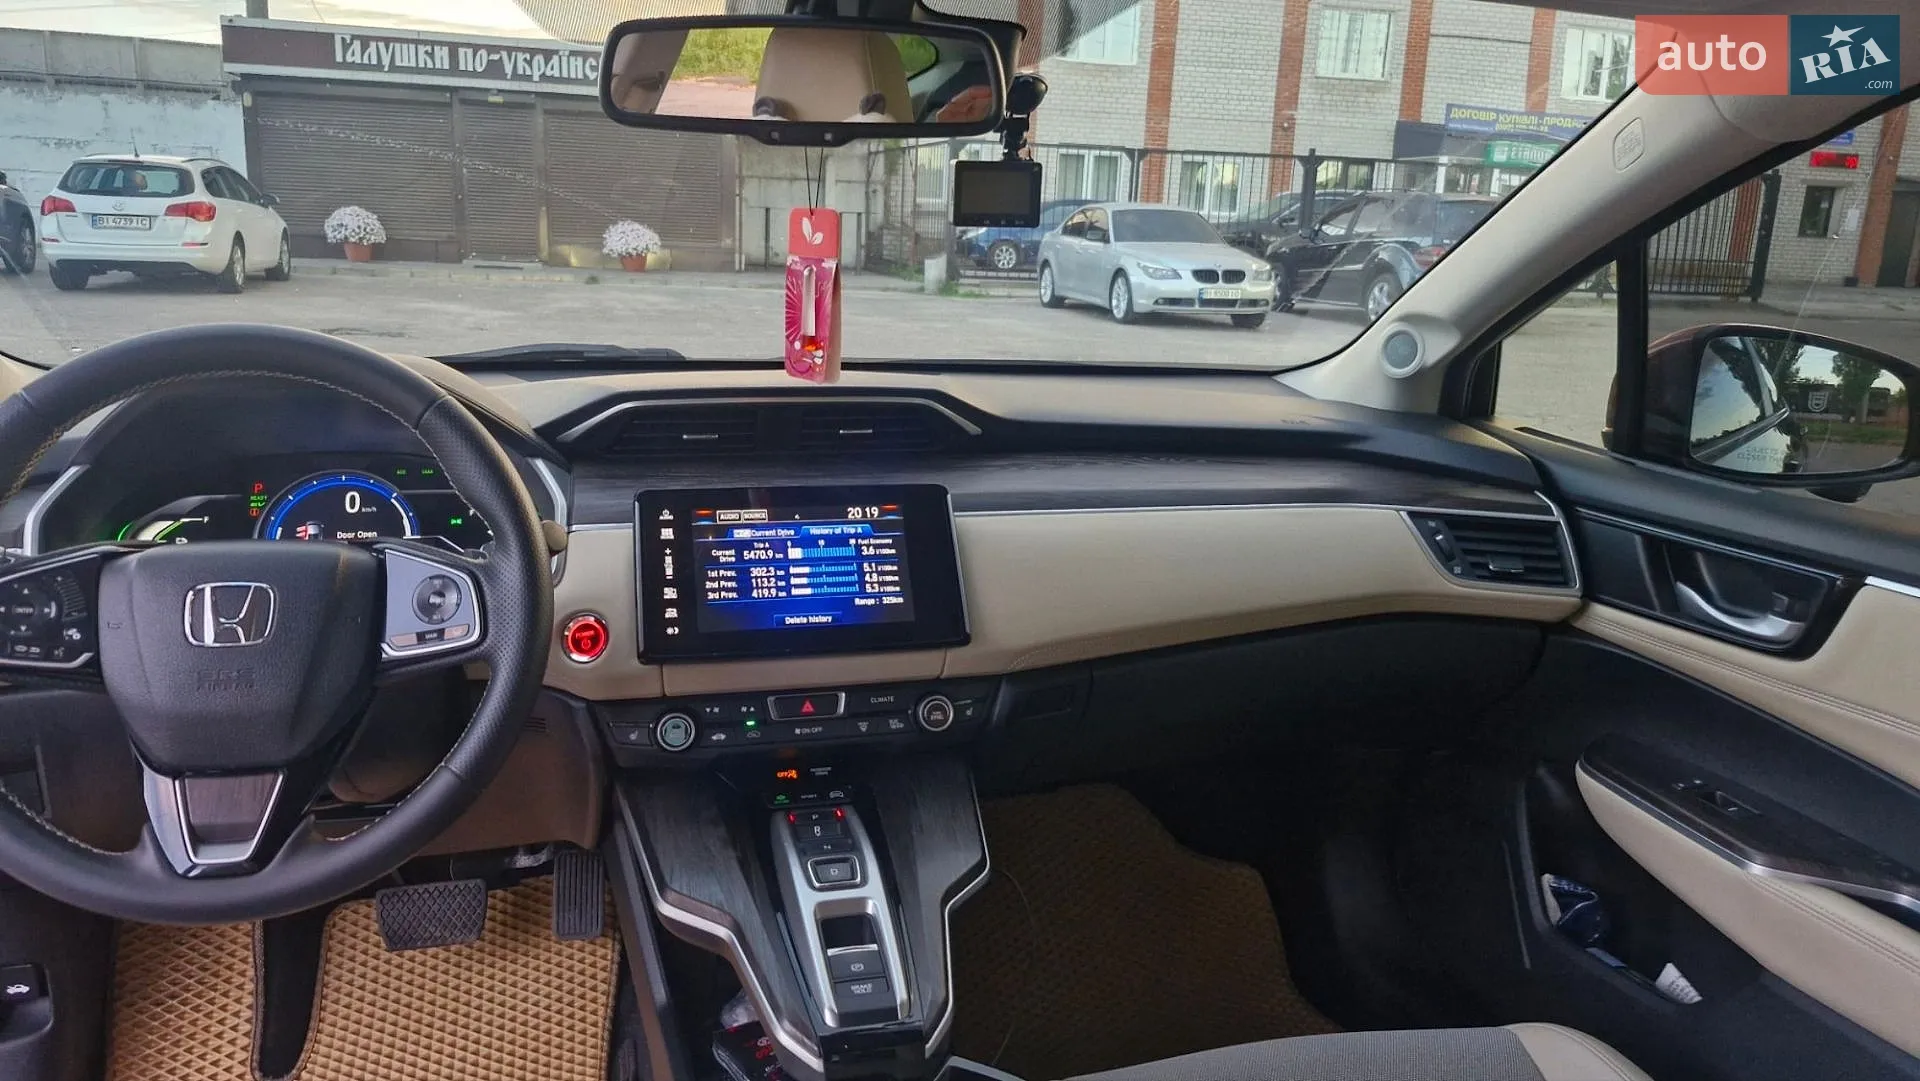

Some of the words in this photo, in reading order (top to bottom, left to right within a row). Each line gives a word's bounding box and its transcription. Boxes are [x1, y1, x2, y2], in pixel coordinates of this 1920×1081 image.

[334, 34, 450, 71] Галушки
[458, 47, 599, 81] по-українс
[1450, 107, 1497, 121] ДОГОВІР
[254, 482, 263, 494] P
[345, 490, 361, 514] 0
[847, 507, 862, 518] 20
[865, 507, 879, 518] 19
[336, 530, 355, 540] Door
[357, 529, 378, 540] Open
[752, 528, 776, 537] Current
[777, 528, 795, 538] Drive
[810, 528, 833, 536] History
[843, 527, 856, 536] Trip
[711, 549, 736, 557] Current
[743, 549, 774, 561] 5470.9
[861, 546, 875, 556] 3.6
[749, 567, 775, 578] 302.3
[863, 563, 876, 572] 5.1
[707, 569, 719, 578] 1st
[720, 569, 738, 578] Prev.
[864, 573, 878, 582] 4.8
[719, 580, 738, 588] Prev.
[751, 578, 776, 588] 113.2
[865, 583, 879, 593] 5.3
[707, 591, 720, 599] 3rd
[720, 591, 739, 599] Prev.
[751, 588, 777, 599] 419.9
[854, 598, 875, 606] Range
[785, 616, 807, 625] Delete
[808, 614, 833, 624] history
[870, 696, 895, 704] CLIMATE
